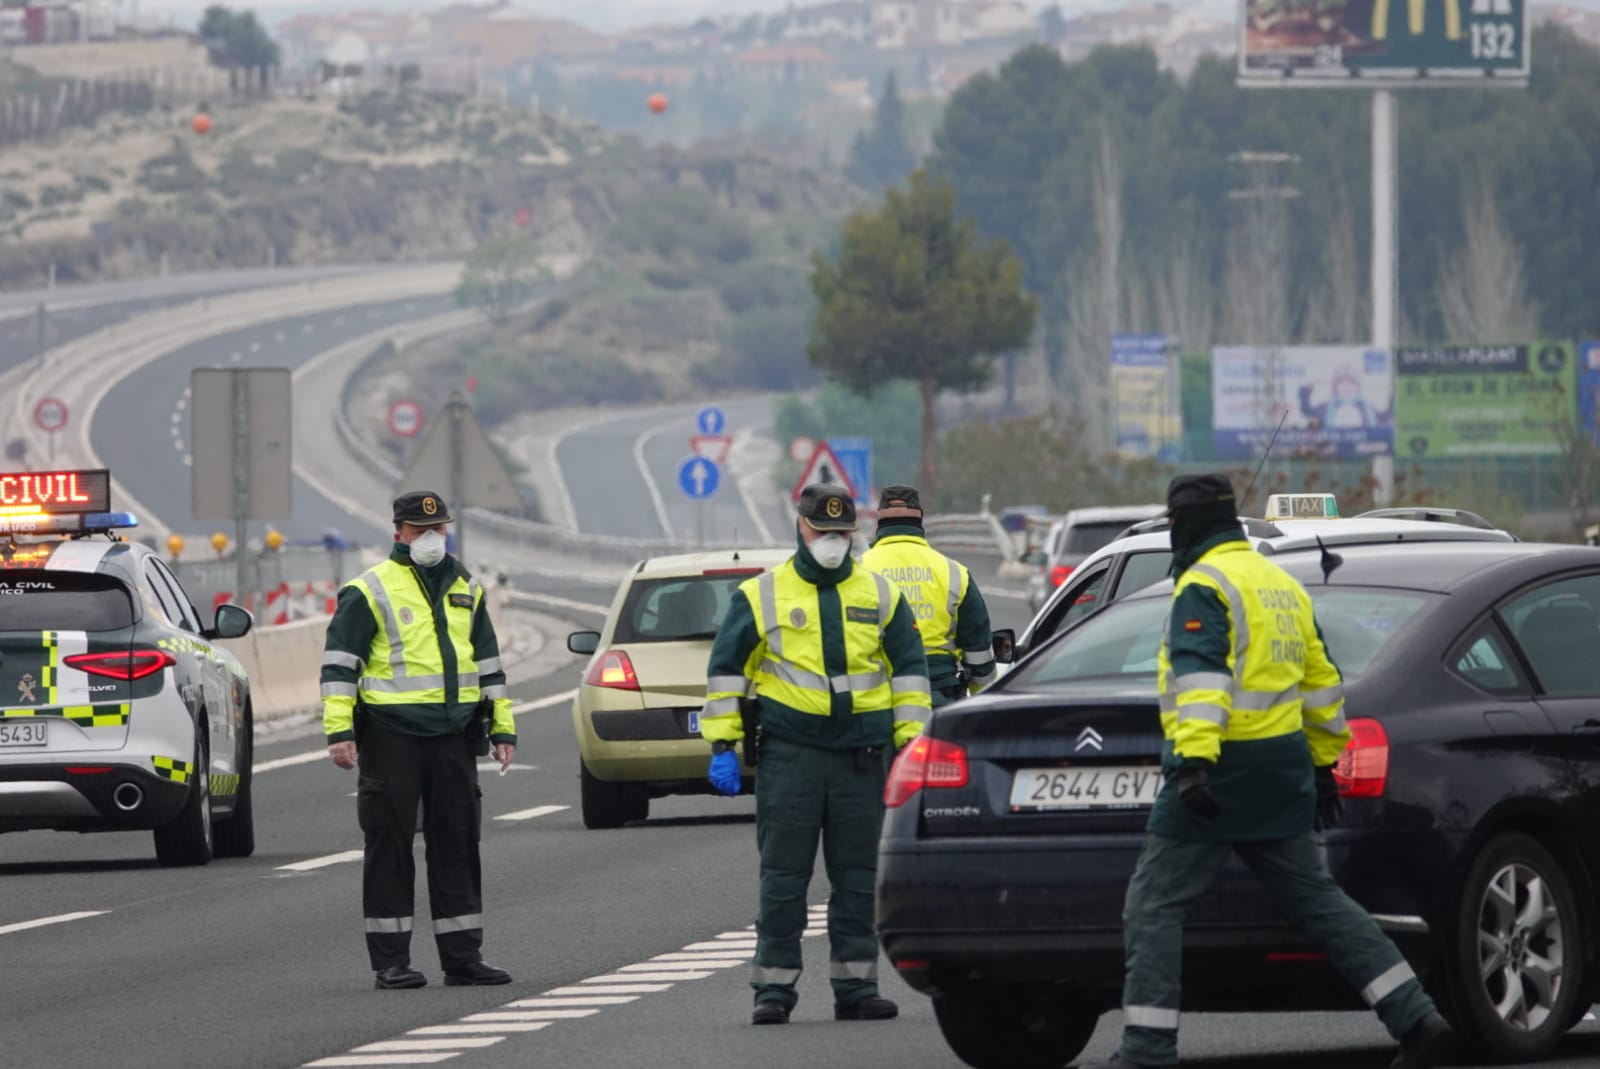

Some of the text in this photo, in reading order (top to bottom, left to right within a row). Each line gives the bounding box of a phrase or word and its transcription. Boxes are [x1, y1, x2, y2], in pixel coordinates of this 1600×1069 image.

[1471, 22, 1515, 59] 132
[0, 474, 89, 503] CIVIL
[1293, 497, 1324, 513] TAXI
[881, 566, 934, 583] GUARDIA
[898, 584, 924, 602] IVIL
[69, 685, 117, 694] ELVIO
[0, 725, 46, 743] 543U
[1031, 771, 1165, 801] 2644 GVT
